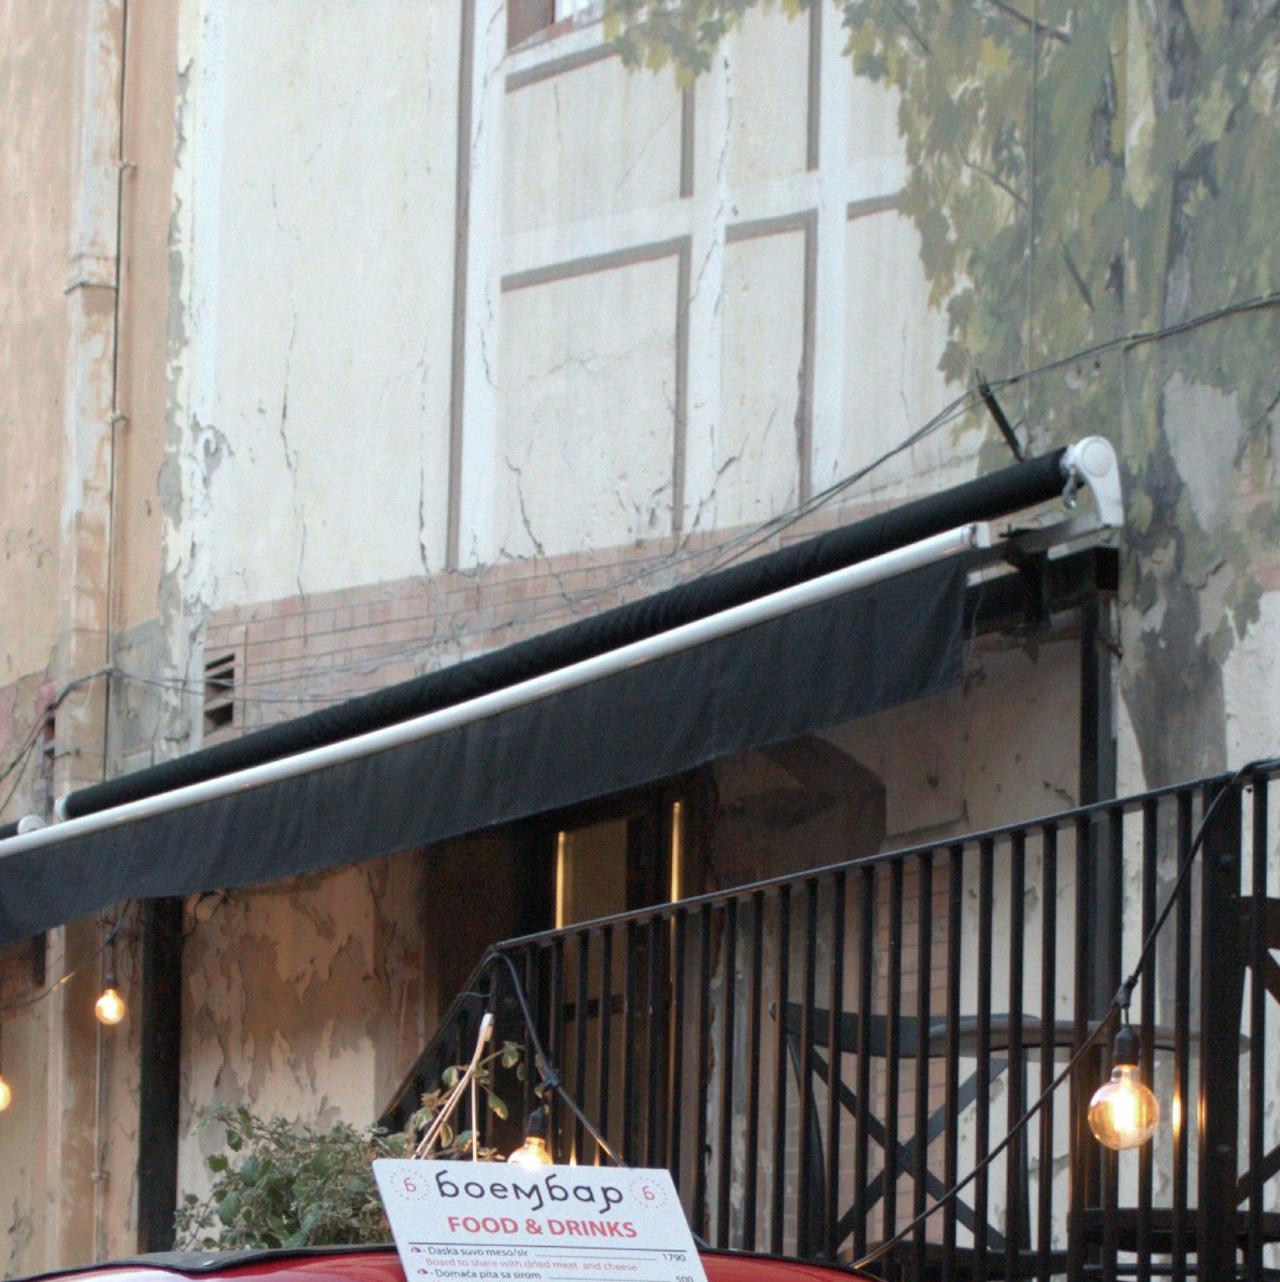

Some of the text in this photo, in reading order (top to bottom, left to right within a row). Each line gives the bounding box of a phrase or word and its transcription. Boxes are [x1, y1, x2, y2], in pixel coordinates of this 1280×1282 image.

[447, 1216, 638, 1239] FOOD & DRINKS
[428, 1246, 459, 1255] Daska
[662, 1253, 687, 1261] 1790
[425, 1257, 638, 1271] Board to share with dried meat and cheese
[478, 1269, 500, 1280] pita
[512, 1270, 542, 1279] sirom
[675, 1275, 695, 1282] 500
